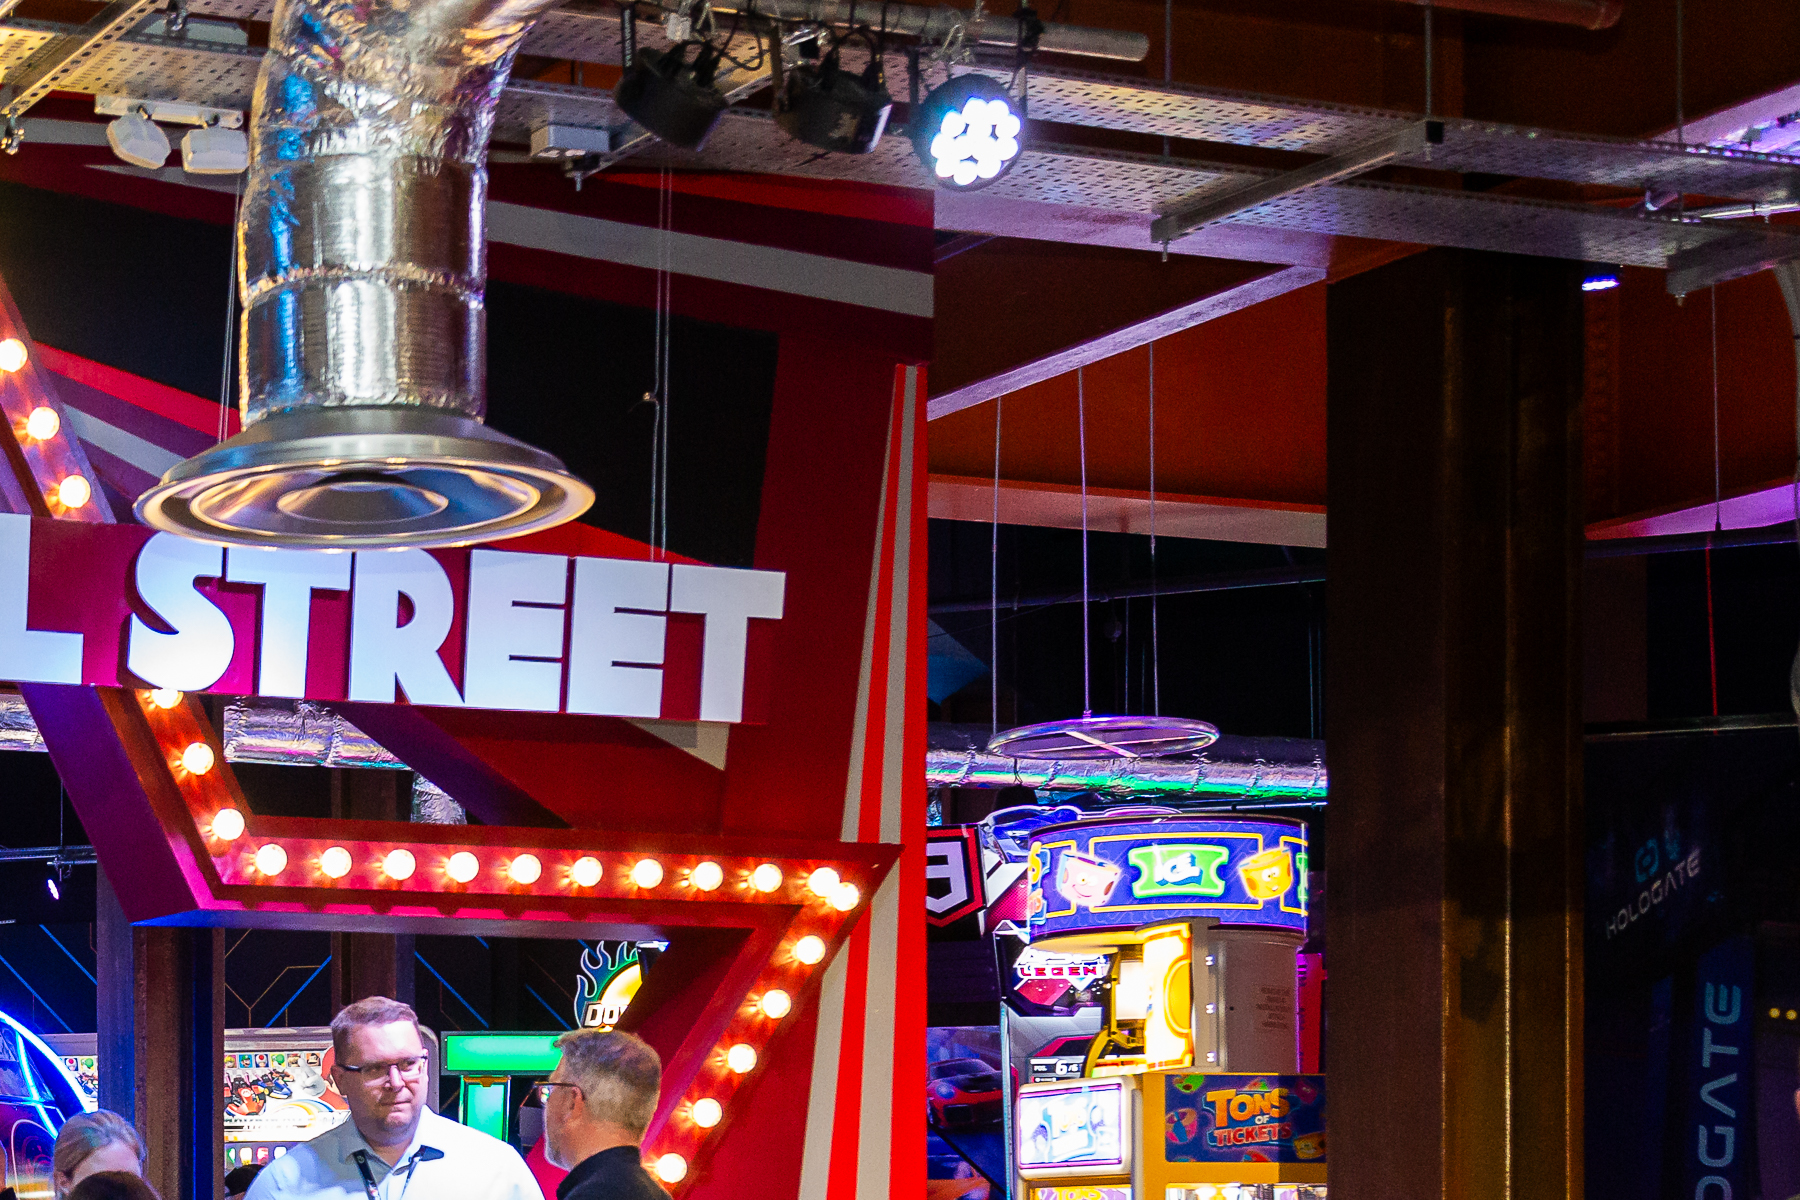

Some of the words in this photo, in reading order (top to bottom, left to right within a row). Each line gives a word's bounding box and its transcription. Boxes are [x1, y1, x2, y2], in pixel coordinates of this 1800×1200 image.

[127, 527, 787, 724] STREET
[1153, 848, 1202, 884] ICE
[1605, 848, 1702, 940] HOLOGATE
[1019, 965, 1104, 978] LEGEN
[1206, 1087, 1290, 1128] TONS
[1254, 1114, 1270, 1125] OF
[1213, 1121, 1292, 1147] TICKETS
